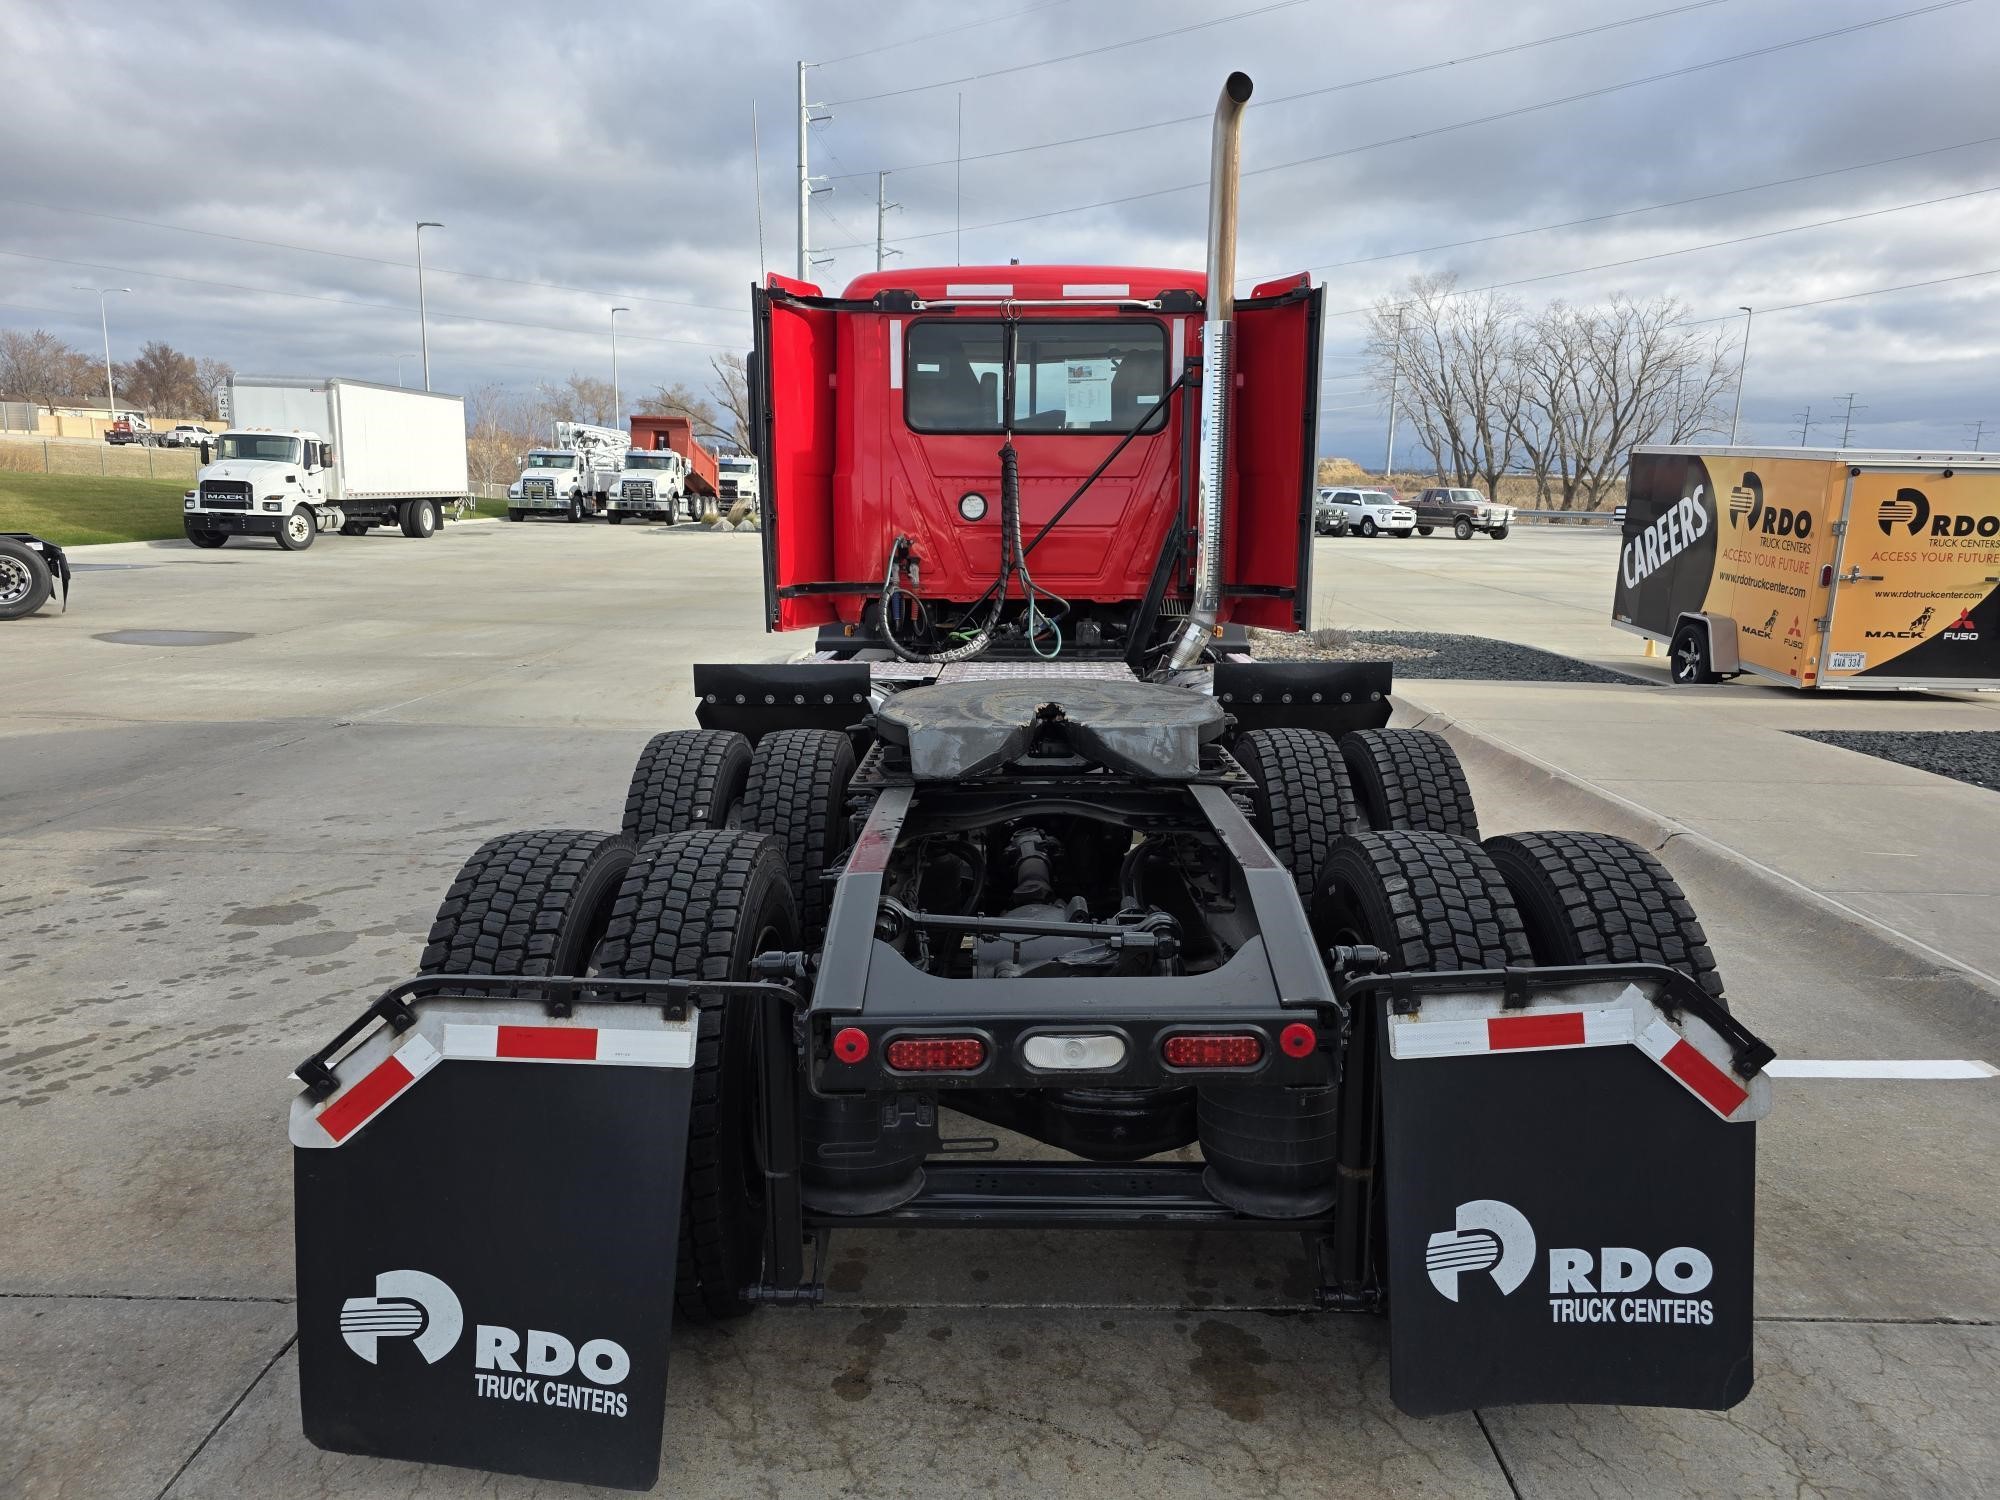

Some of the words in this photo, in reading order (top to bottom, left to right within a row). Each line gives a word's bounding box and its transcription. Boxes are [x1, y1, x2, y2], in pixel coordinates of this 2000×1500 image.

[1761, 506, 1813, 539] RDO
[1930, 515, 2000, 537] RDO
[1623, 484, 1708, 589] CAREERS
[1760, 536, 1780, 550] TRUCK
[1782, 540, 1812, 555] CENTERS
[1929, 538, 1958, 548] TRUCK
[1960, 539, 2000, 549] CENTERS
[1722, 547, 1753, 564] ACCESS
[1754, 552, 1776, 569] YOUR
[1778, 556, 1810, 575] FUTURE
[1871, 551, 1918, 562] ACCESS
[1921, 552, 1954, 563] YOUR
[1957, 552, 2000, 564] FUTURE
[1719, 571, 1806, 599] www.rdotruckcenter.com
[1875, 589, 1983, 600] www.rdotruckcenter.com
[1742, 625, 1772, 640] MACK
[1864, 630, 1925, 639] MACK
[1943, 632, 1979, 641] FUSO
[1783, 638, 1803, 650] FUSO
[1549, 1246, 1713, 1294] RDO
[1549, 1298, 1616, 1323] TRUCK
[1620, 1298, 1714, 1325] CENTERS
[475, 1324, 631, 1385] RDO
[474, 1373, 539, 1403] TRUCK
[543, 1381, 628, 1418] CENTERS
